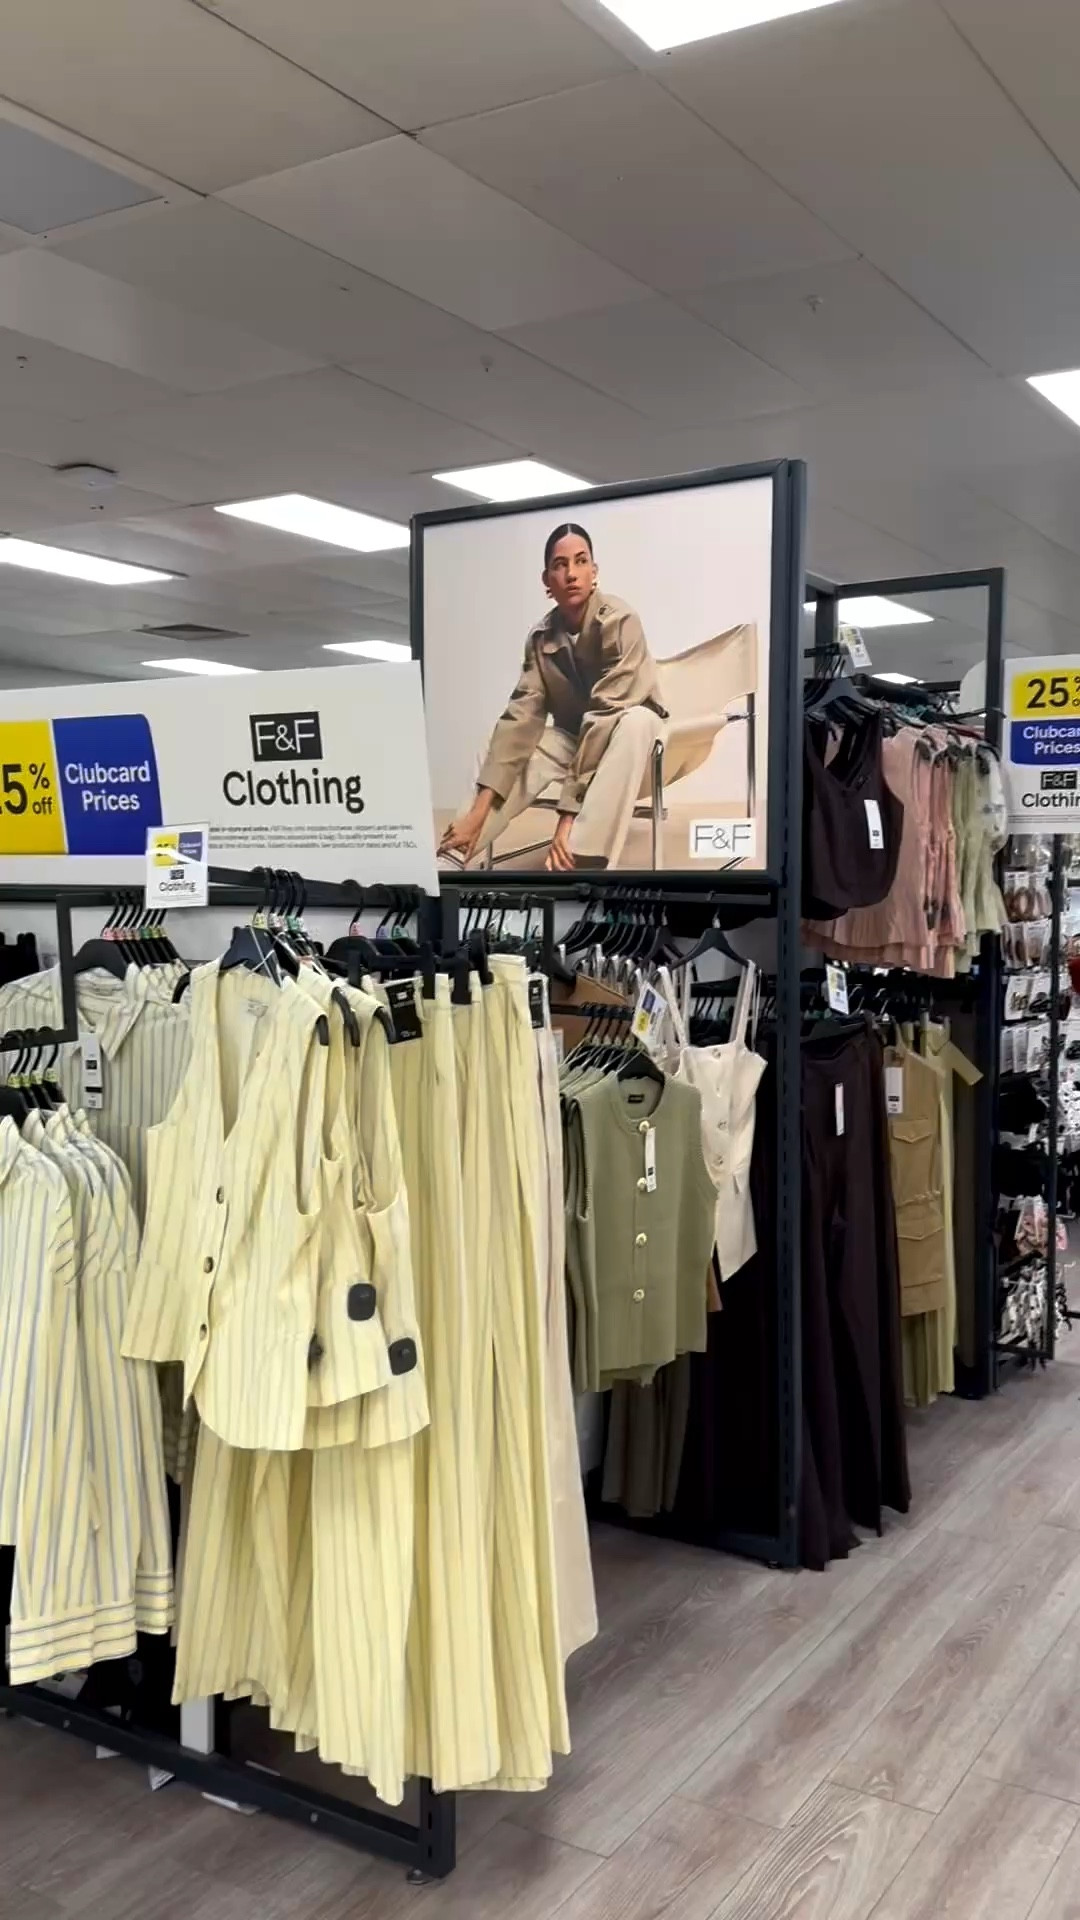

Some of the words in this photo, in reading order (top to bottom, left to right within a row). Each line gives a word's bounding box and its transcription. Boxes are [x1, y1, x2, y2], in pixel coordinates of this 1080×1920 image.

[254, 718, 316, 756] F&F
[1023, 724, 1080, 740] Clubcar
[64, 760, 151, 784] Clubcard
[1042, 772, 1075, 788] F&F
[0, 762, 50, 815] 5%
[81, 789, 141, 811] Prices
[222, 767, 365, 814] Clothing
[32, 797, 52, 815] off
[695, 824, 752, 852] F&F
